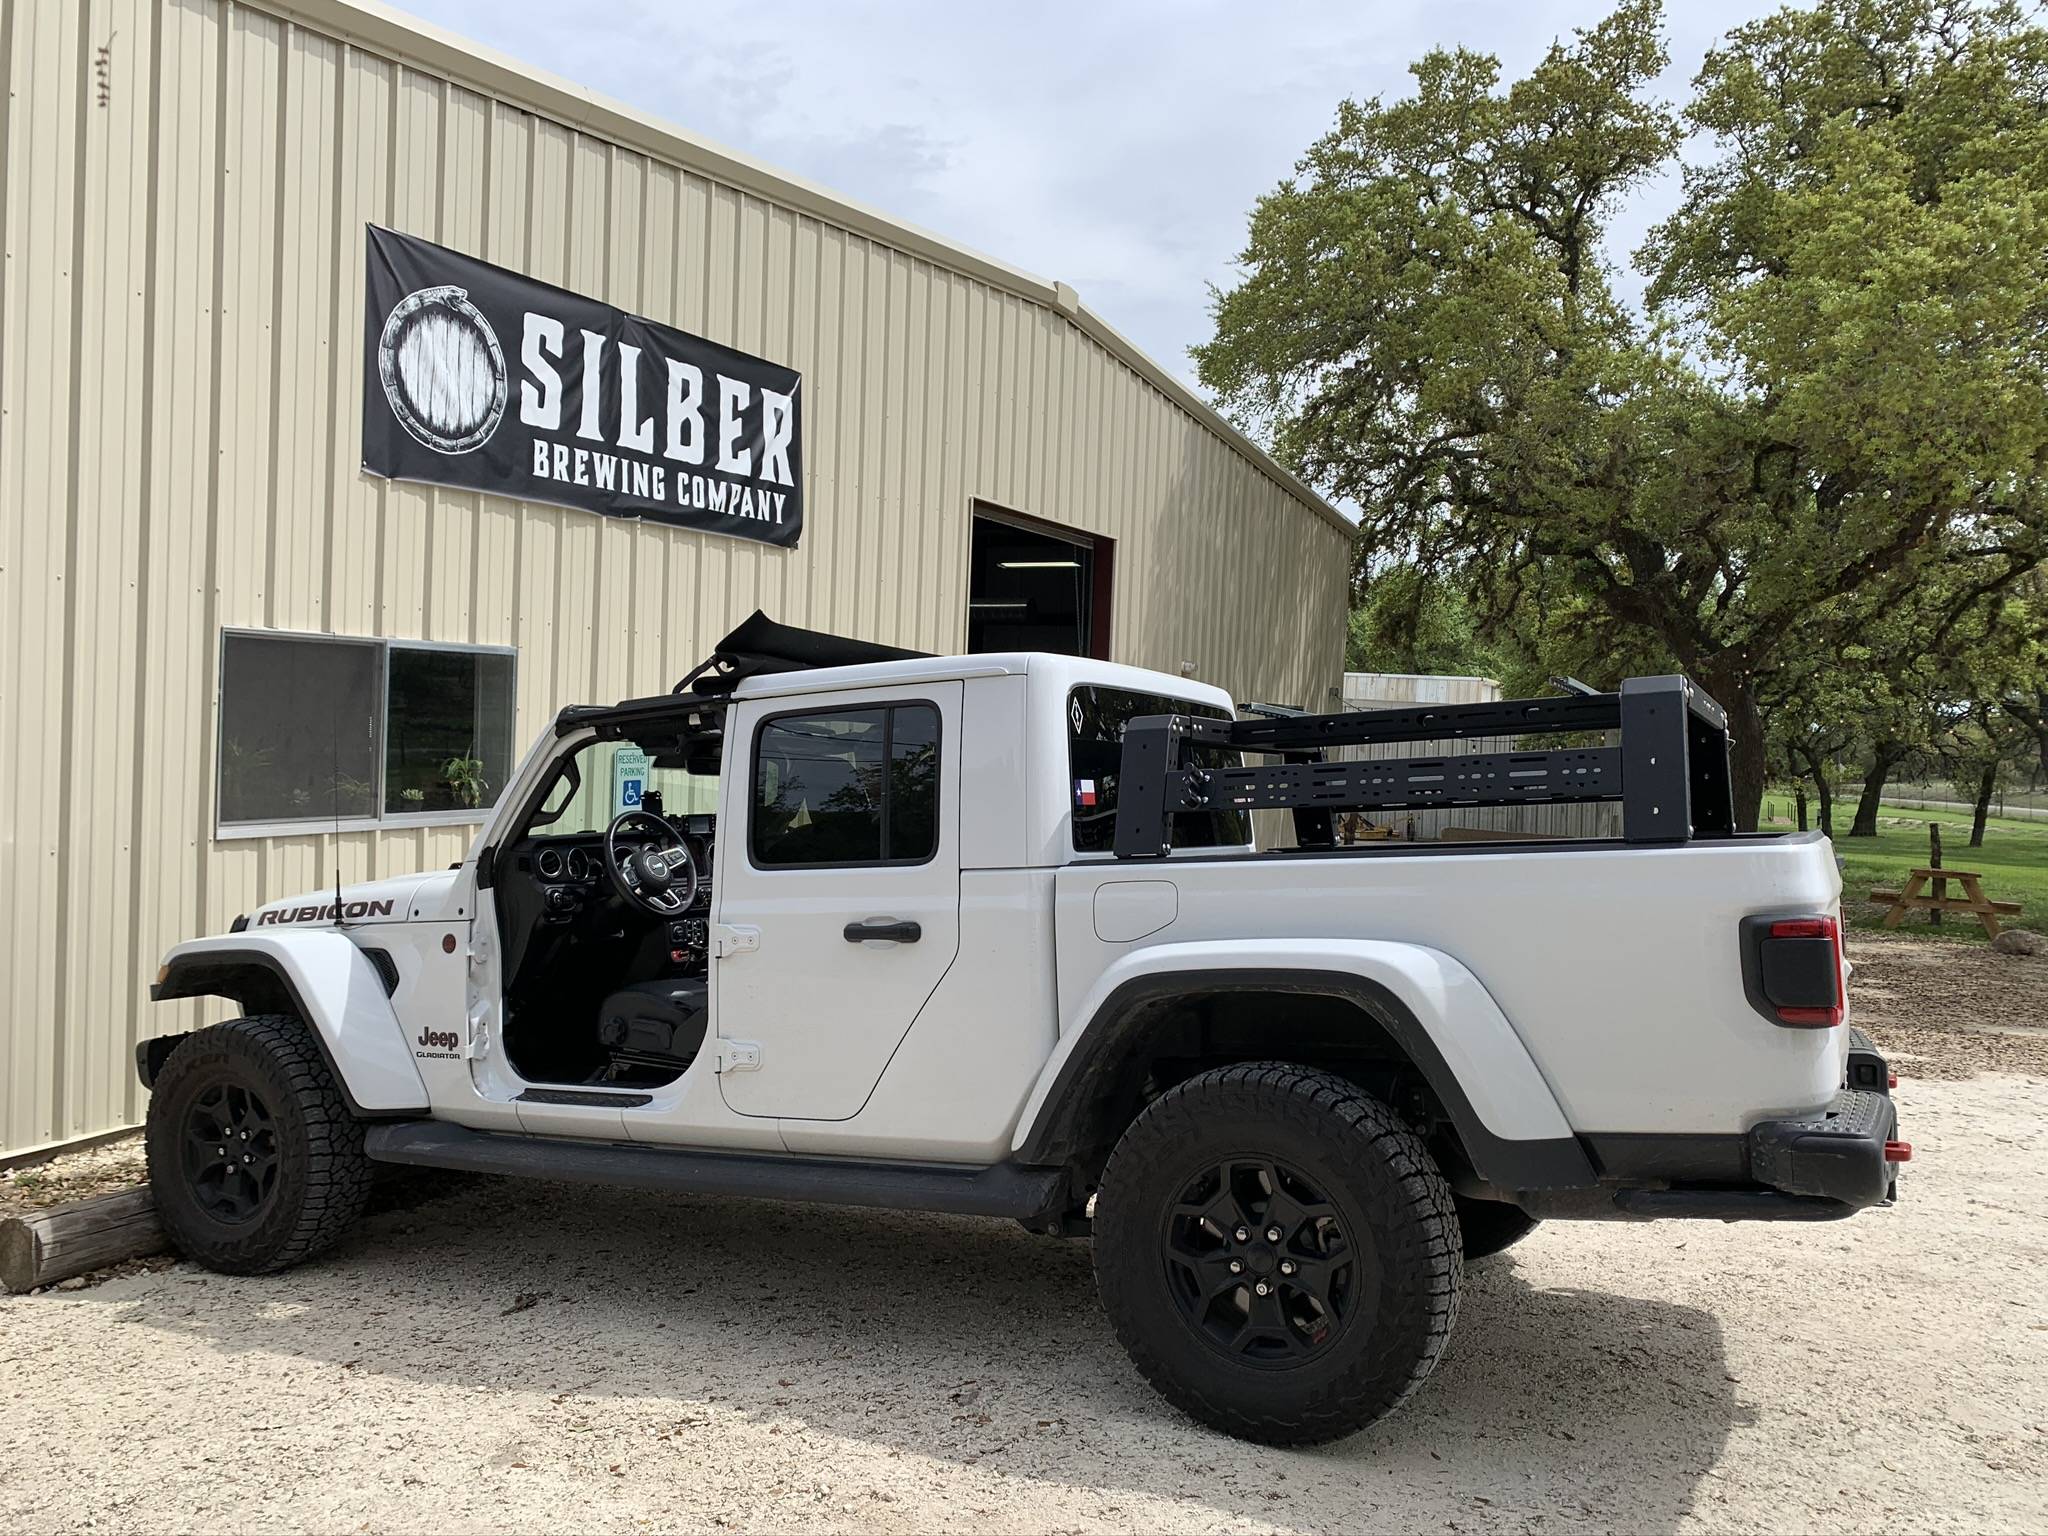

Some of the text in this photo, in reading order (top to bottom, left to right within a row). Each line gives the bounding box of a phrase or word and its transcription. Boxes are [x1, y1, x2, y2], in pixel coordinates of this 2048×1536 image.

[520, 312, 794, 487] SILBER
[533, 438, 786, 525] BREWING COMPANY
[618, 754, 647, 764] RESERVED
[620, 767, 645, 776] PARKING
[257, 899, 394, 926] RUBICON
[418, 1026, 458, 1051] Jeep
[416, 1051, 461, 1060] GLADIATOR
